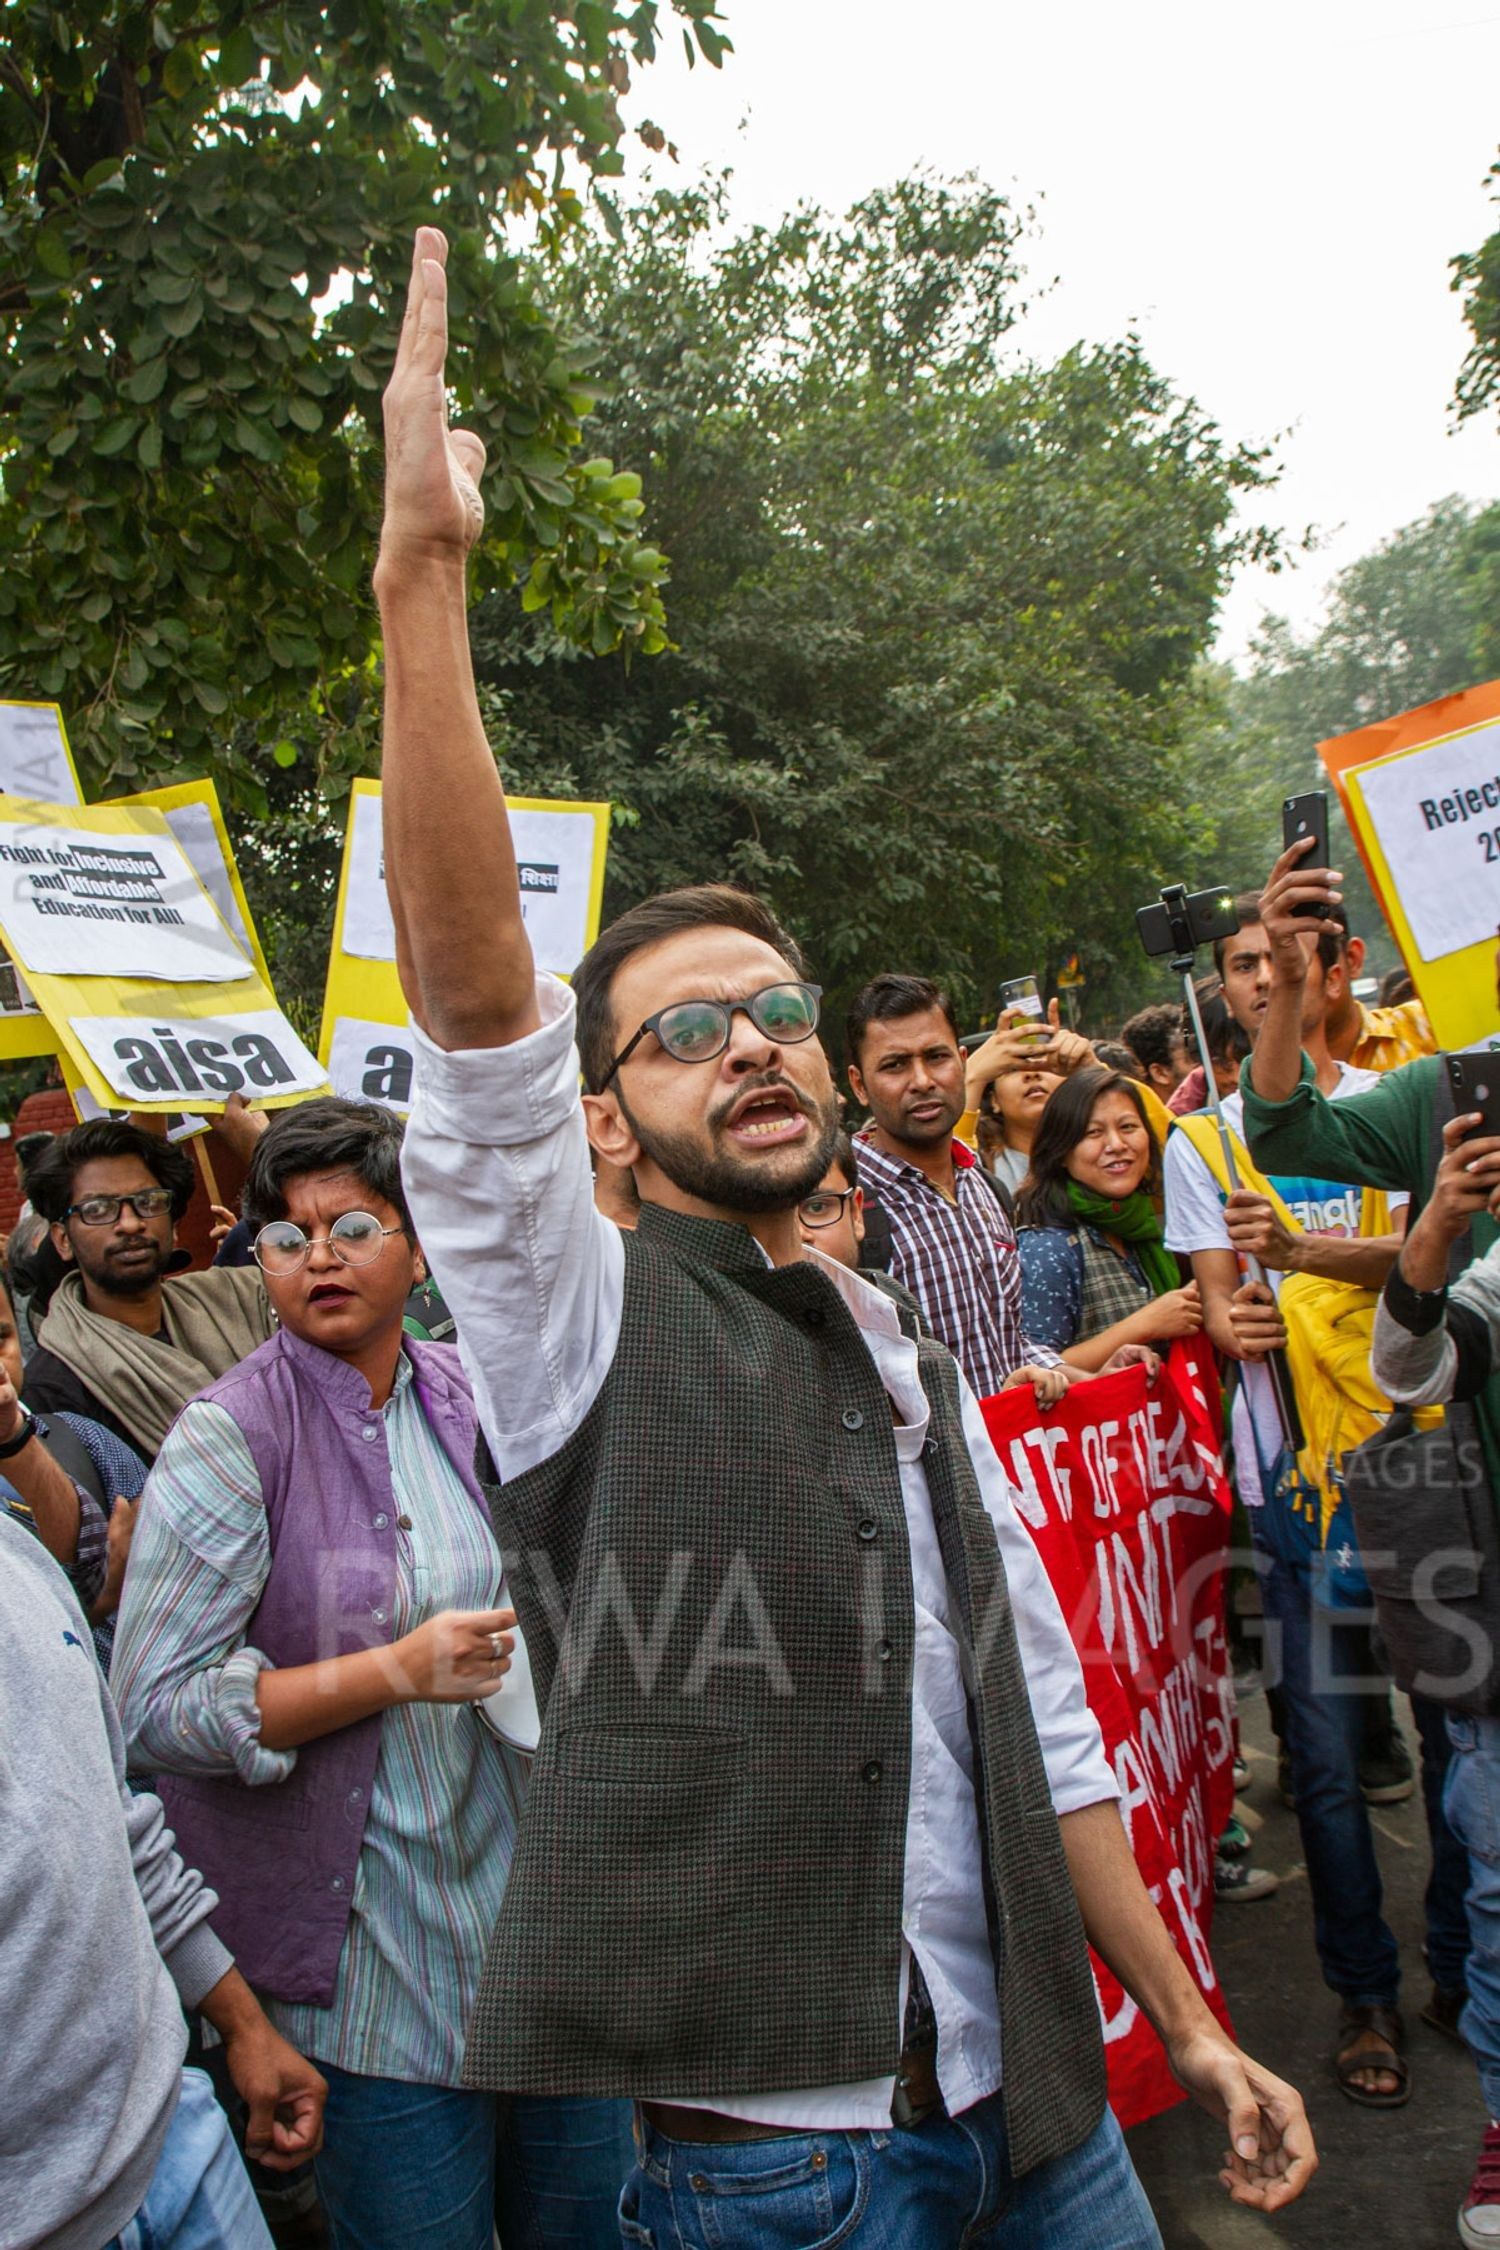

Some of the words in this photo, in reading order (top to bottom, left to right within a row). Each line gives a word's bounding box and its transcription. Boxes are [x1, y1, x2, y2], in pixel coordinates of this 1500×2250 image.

[0, 844, 49, 865] Fight
[49, 848, 76, 868] for
[76, 852, 160, 876] Inclusive
[29, 872, 67, 891] and
[67, 874, 161, 899] Affordable
[32, 897, 126, 922] Education
[125, 906, 151, 924] for
[152, 907, 185, 925] All!
[113, 1027, 297, 1093] aisa
[1287, 1189, 1362, 1238] angl
[1081, 1420, 1121, 1518] OF
